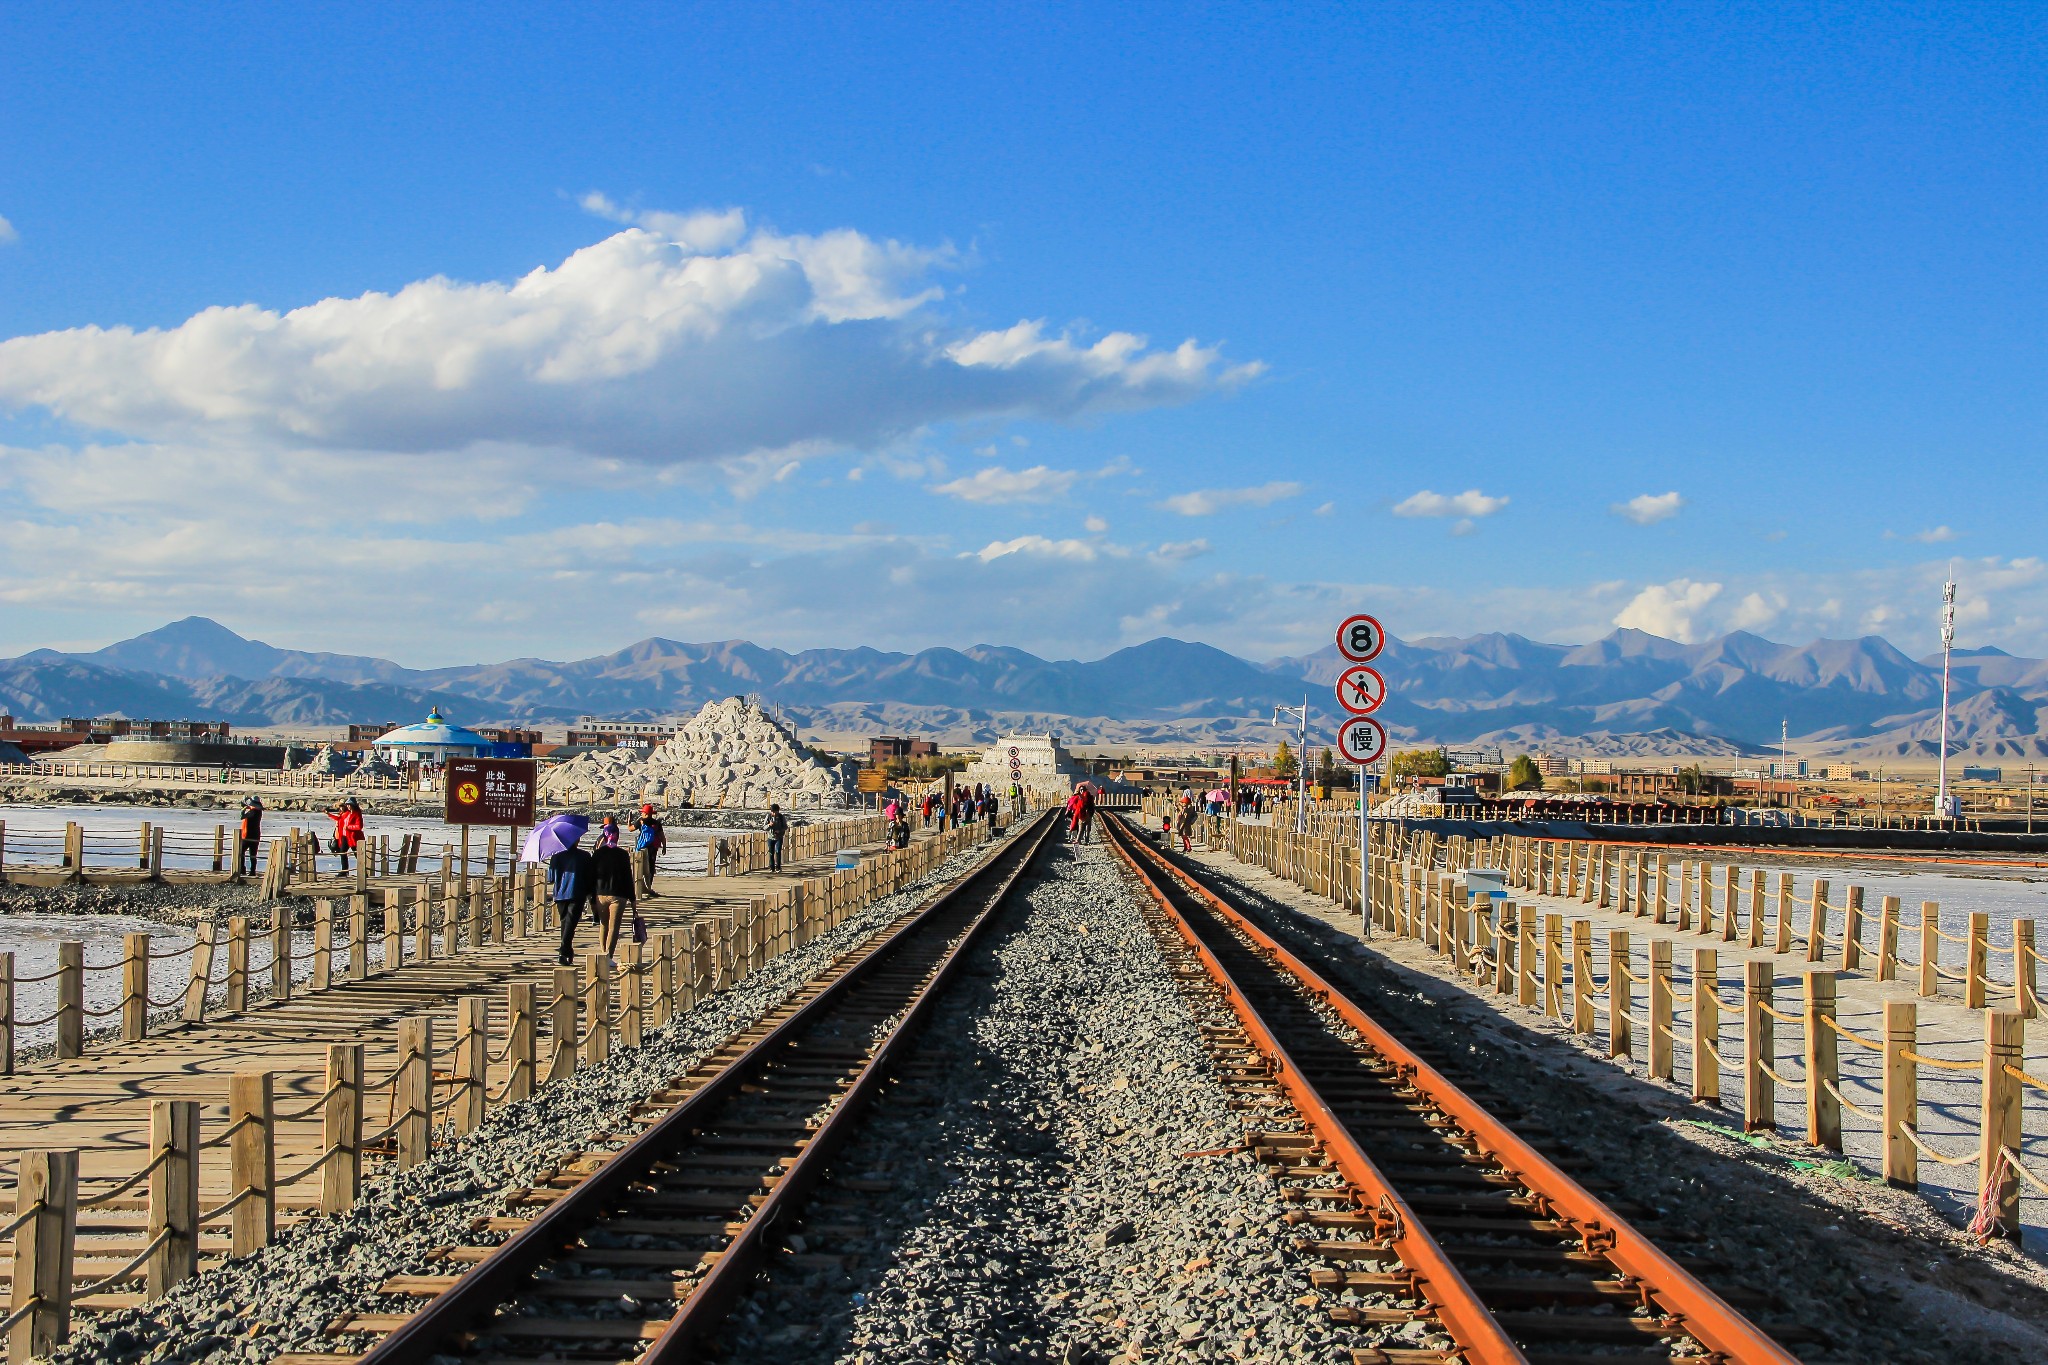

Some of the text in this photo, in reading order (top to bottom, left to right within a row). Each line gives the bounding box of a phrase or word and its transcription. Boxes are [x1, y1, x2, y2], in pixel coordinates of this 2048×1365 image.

[1351, 625, 1372, 652] 8
[1350, 727, 1374, 752] 慢
[486, 770, 506, 780] 此处
[486, 782, 526, 792] 禁止下湖
